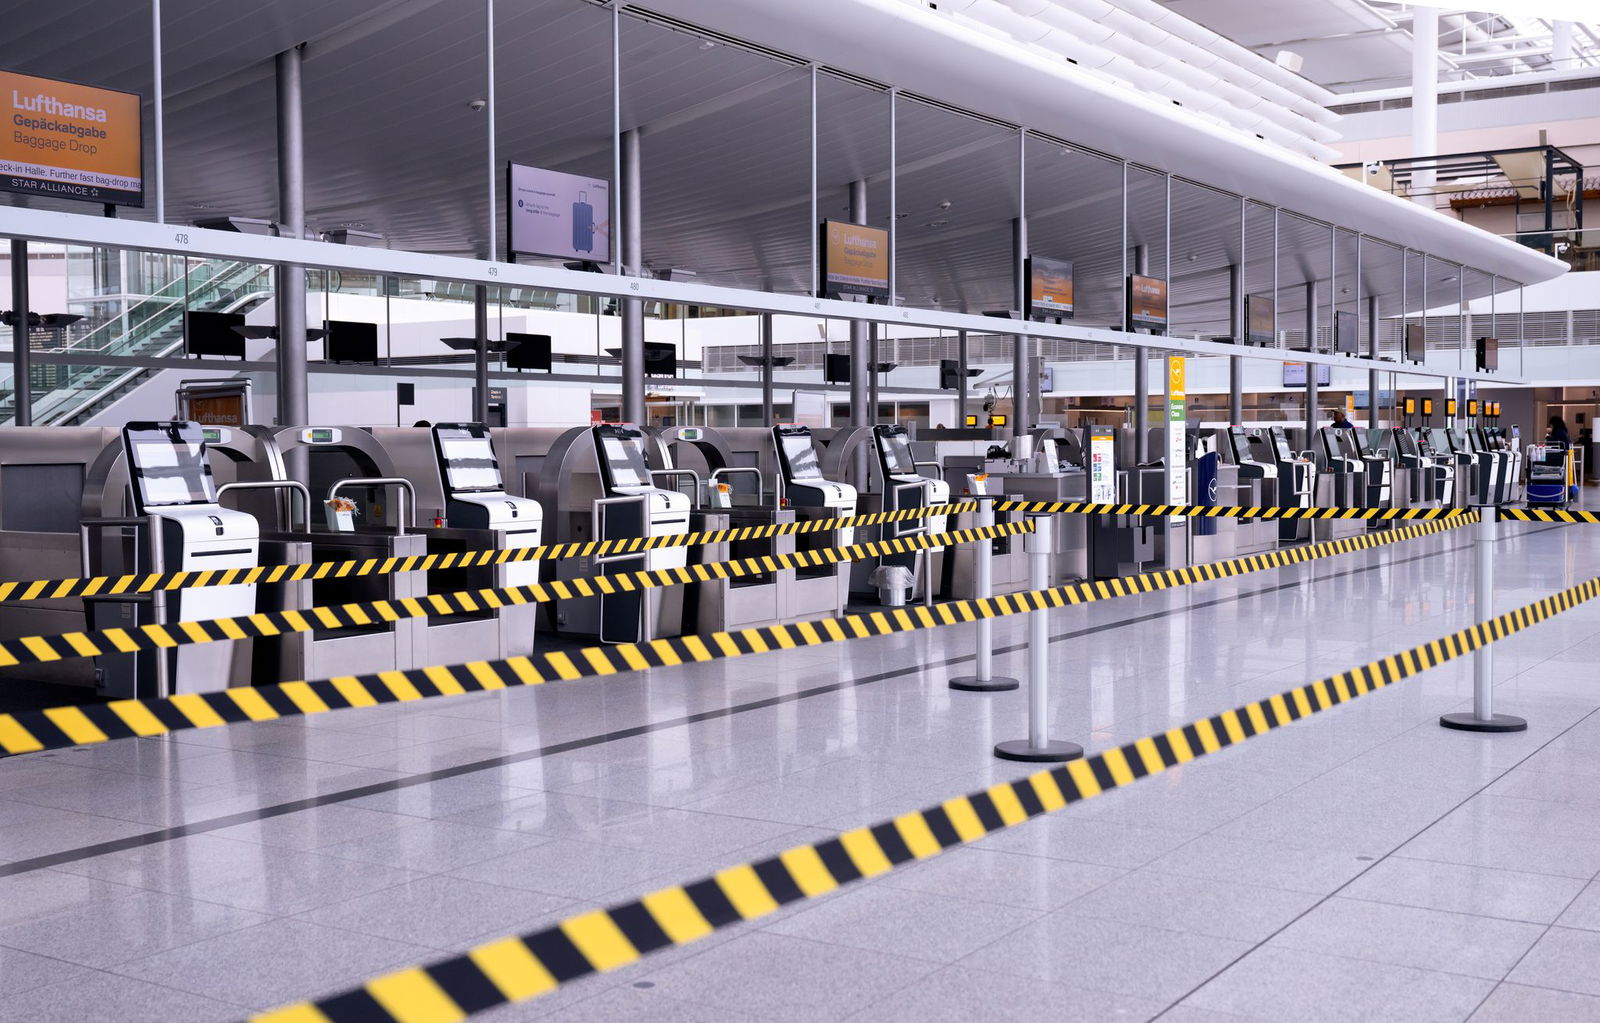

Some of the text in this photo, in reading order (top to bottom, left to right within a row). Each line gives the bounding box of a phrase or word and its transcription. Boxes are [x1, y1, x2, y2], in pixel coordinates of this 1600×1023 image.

[12, 89, 107, 123] Lufthansa
[13, 114, 107, 139] Gepäckabgabe
[14, 131, 98, 156] Baggage Drop
[11, 178, 88, 196] STAR ALLIANCE
[25, 166, 47, 177] Halle.
[50, 169, 78, 181] Further
[79, 172, 94, 183] fast
[96, 175, 129, 189] bag-drop
[174, 233, 189, 245] 478
[488, 267, 498, 277] 479
